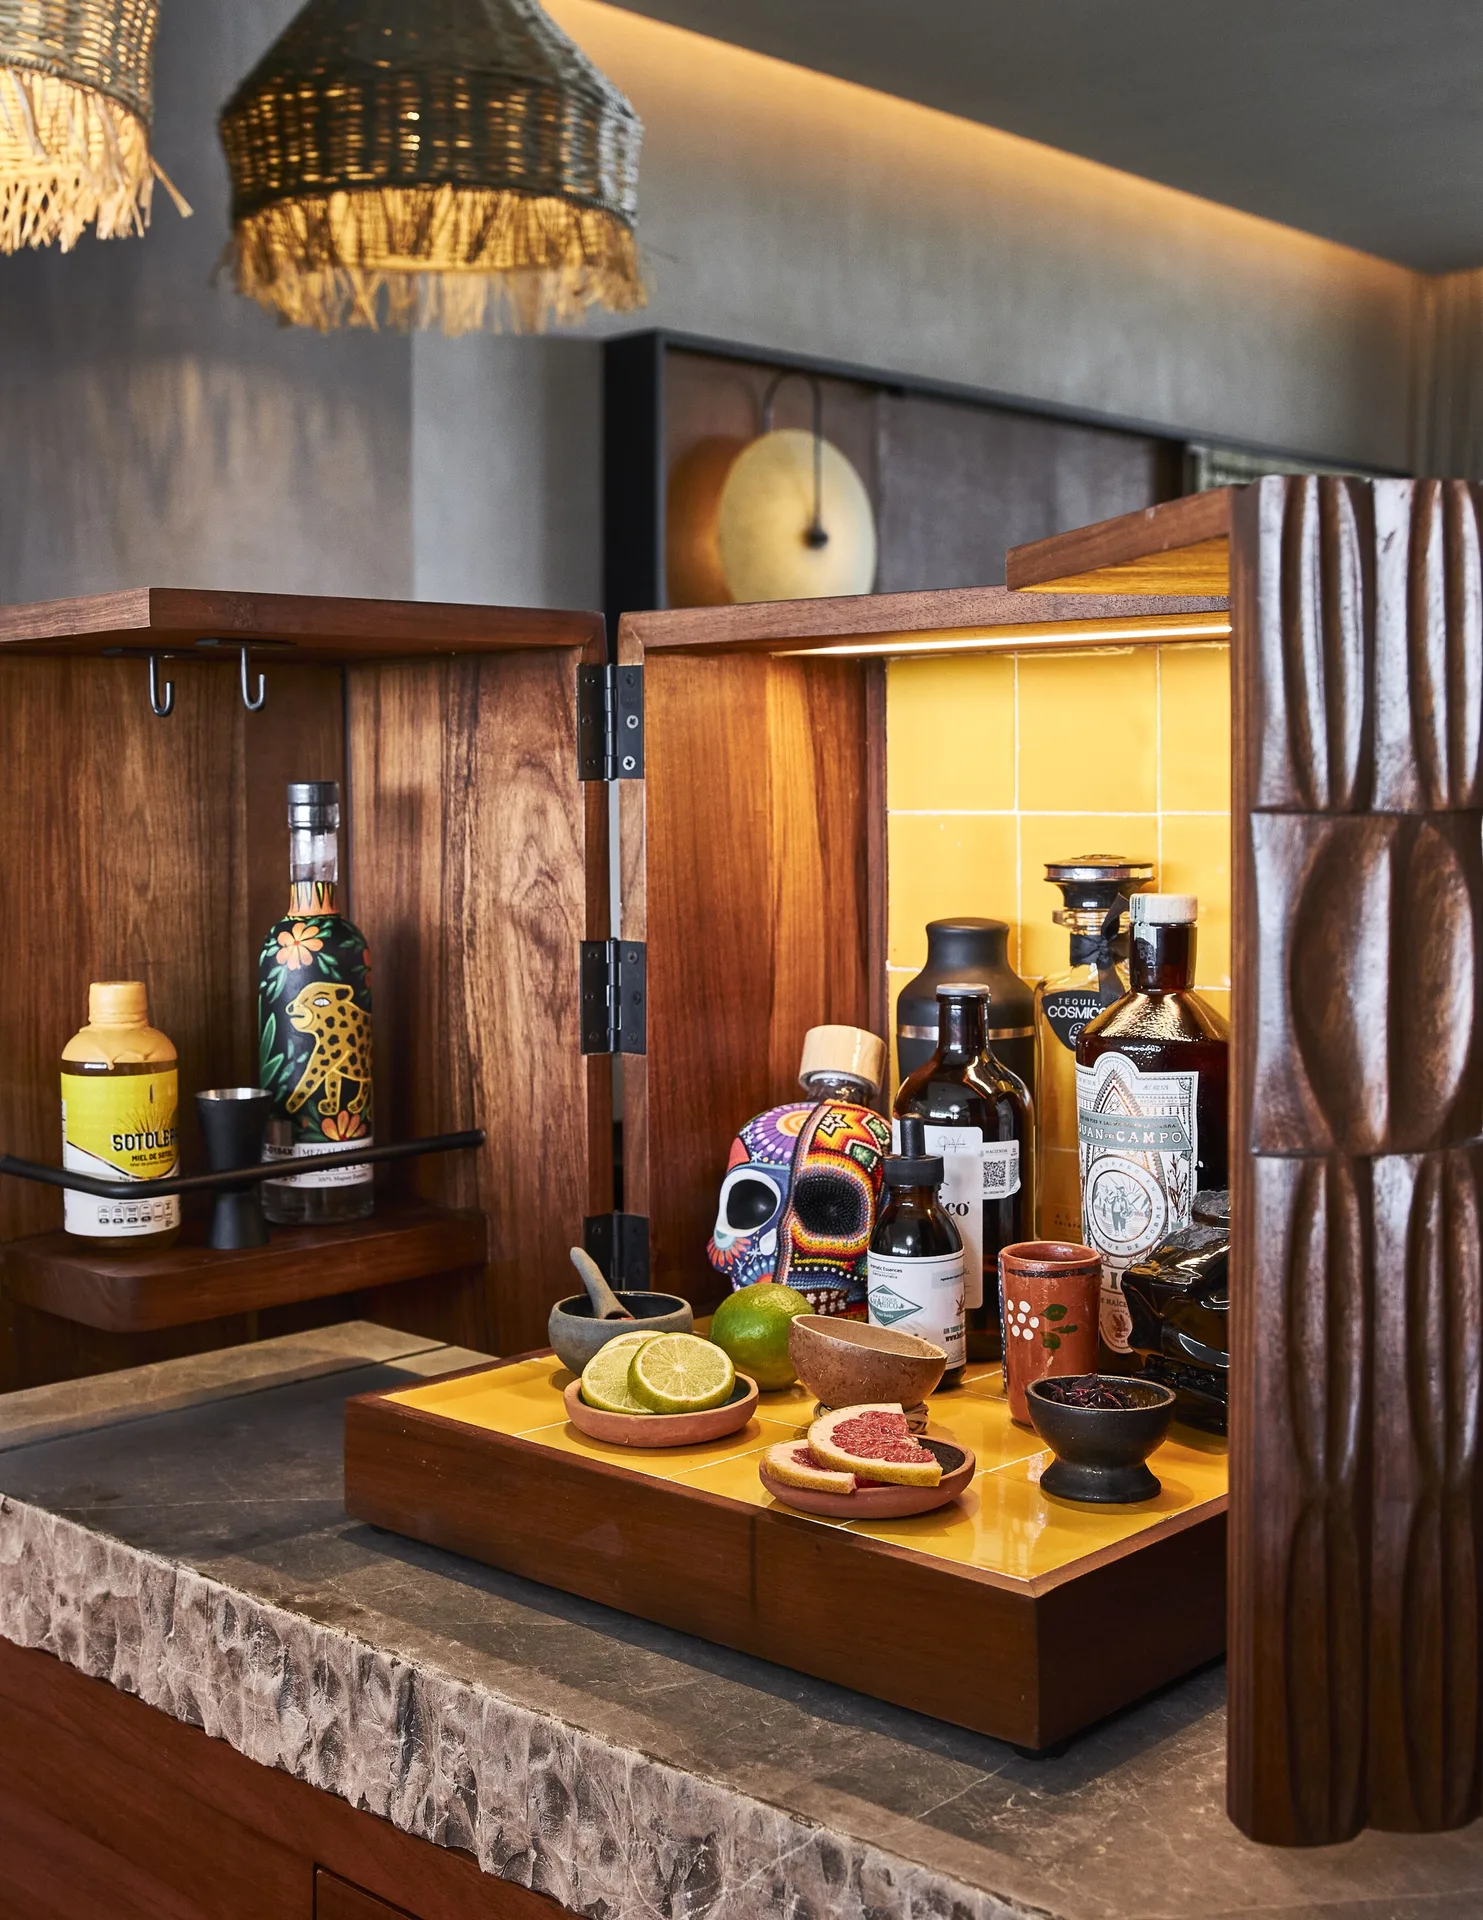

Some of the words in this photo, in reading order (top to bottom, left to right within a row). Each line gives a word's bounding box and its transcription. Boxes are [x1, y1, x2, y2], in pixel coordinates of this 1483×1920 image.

[1057, 997, 1102, 1007] TEQUIL
[1116, 1130, 1182, 1144] CAMPO
[131, 1154, 148, 1162] MIEL
[149, 1152, 157, 1160] DE
[1145, 1206, 1162, 1241] COBRE
[1106, 1298, 1128, 1308] MAÍCE
